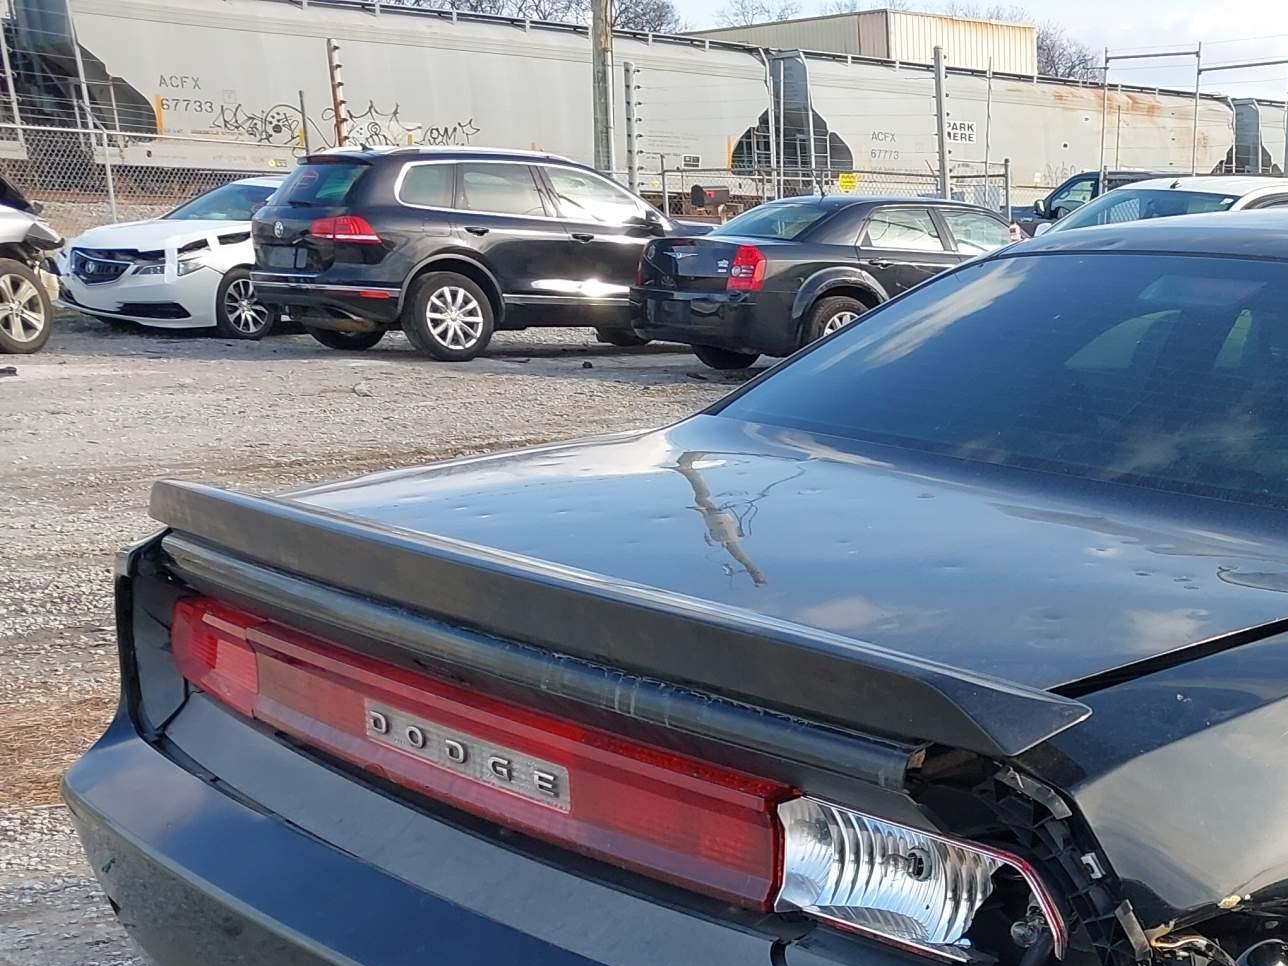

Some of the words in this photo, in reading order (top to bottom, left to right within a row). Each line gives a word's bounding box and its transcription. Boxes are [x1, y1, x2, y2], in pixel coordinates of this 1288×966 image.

[159, 74, 201, 90] ACFX
[160, 98, 214, 113] 67733
[871, 130, 896, 142] ACFX
[948, 131, 975, 142] ERE
[369, 710, 559, 798] DODGE
